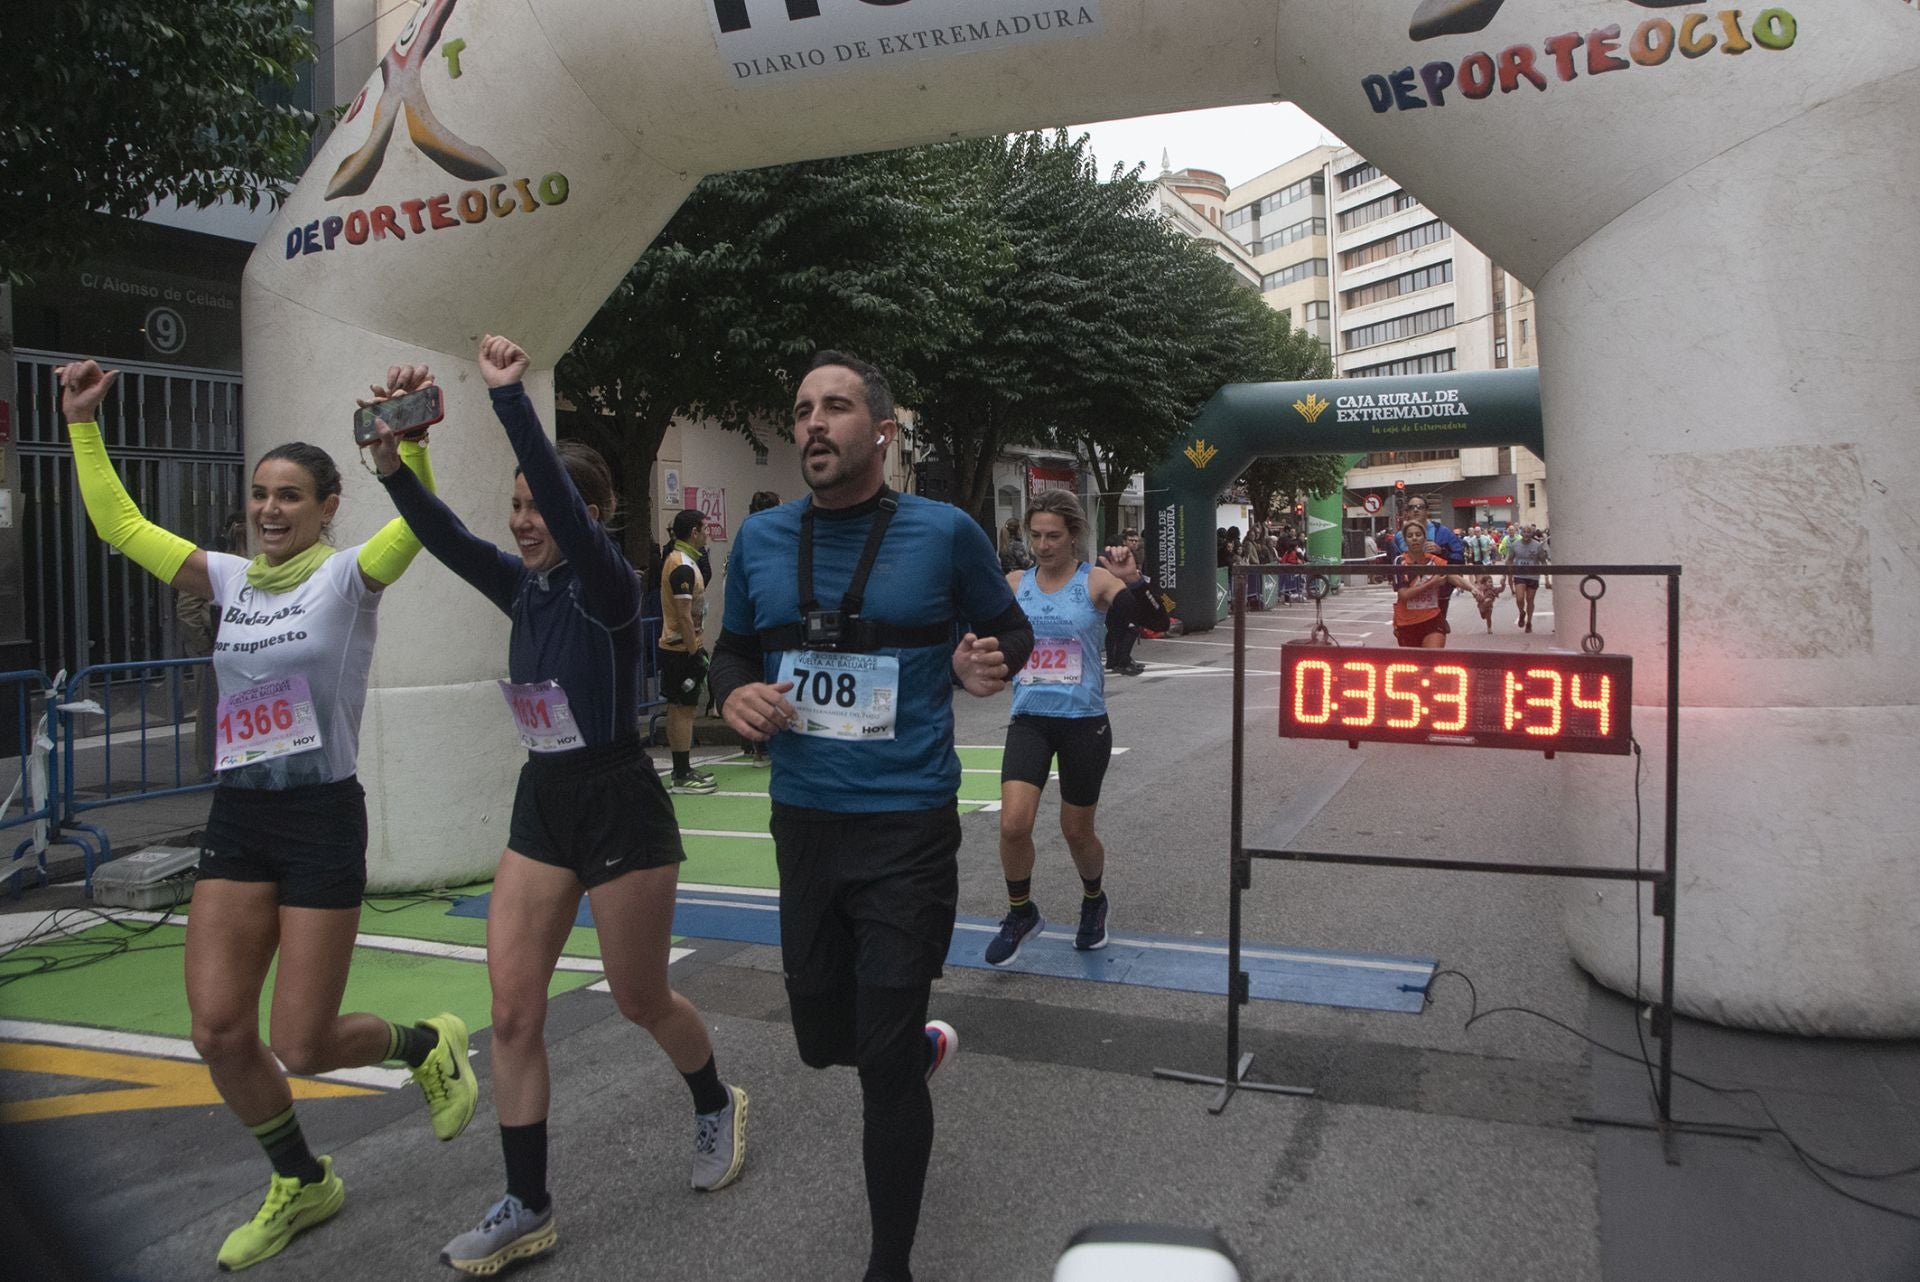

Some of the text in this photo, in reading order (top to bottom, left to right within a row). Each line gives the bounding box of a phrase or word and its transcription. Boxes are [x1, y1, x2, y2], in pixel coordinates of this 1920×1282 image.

[733, 48, 826, 79] DIARIO
[834, 41, 871, 63] DE
[877, 6, 1094, 56] EXTREMADURA
[1360, 7, 1797, 114] DEPORTEOCIO
[286, 171, 570, 260] DEPORTEOCIO
[81, 272, 235, 311] C/ Alonso de Celada
[156, 312, 178, 348] 9
[1336, 389, 1459, 409] CAJA RURAL DE
[1336, 402, 1469, 423] EXTREMADURA
[1401, 424, 1411, 432] de
[1414, 421, 1468, 432] Extremadura
[701, 498, 722, 521] 24
[1158, 510, 1168, 589] CAJA RURAL DE
[1166, 504, 1177, 589] EXTREMADURA
[232, 631, 308, 655] supuesto
[799, 656, 823, 667] VUELTA
[838, 660, 879, 671] BALUARTE
[793, 667, 857, 709] 708
[219, 699, 293, 745] 1366
[862, 725, 889, 734] HOY
[293, 735, 316, 747] HOY
[557, 735, 577, 745] HOY
